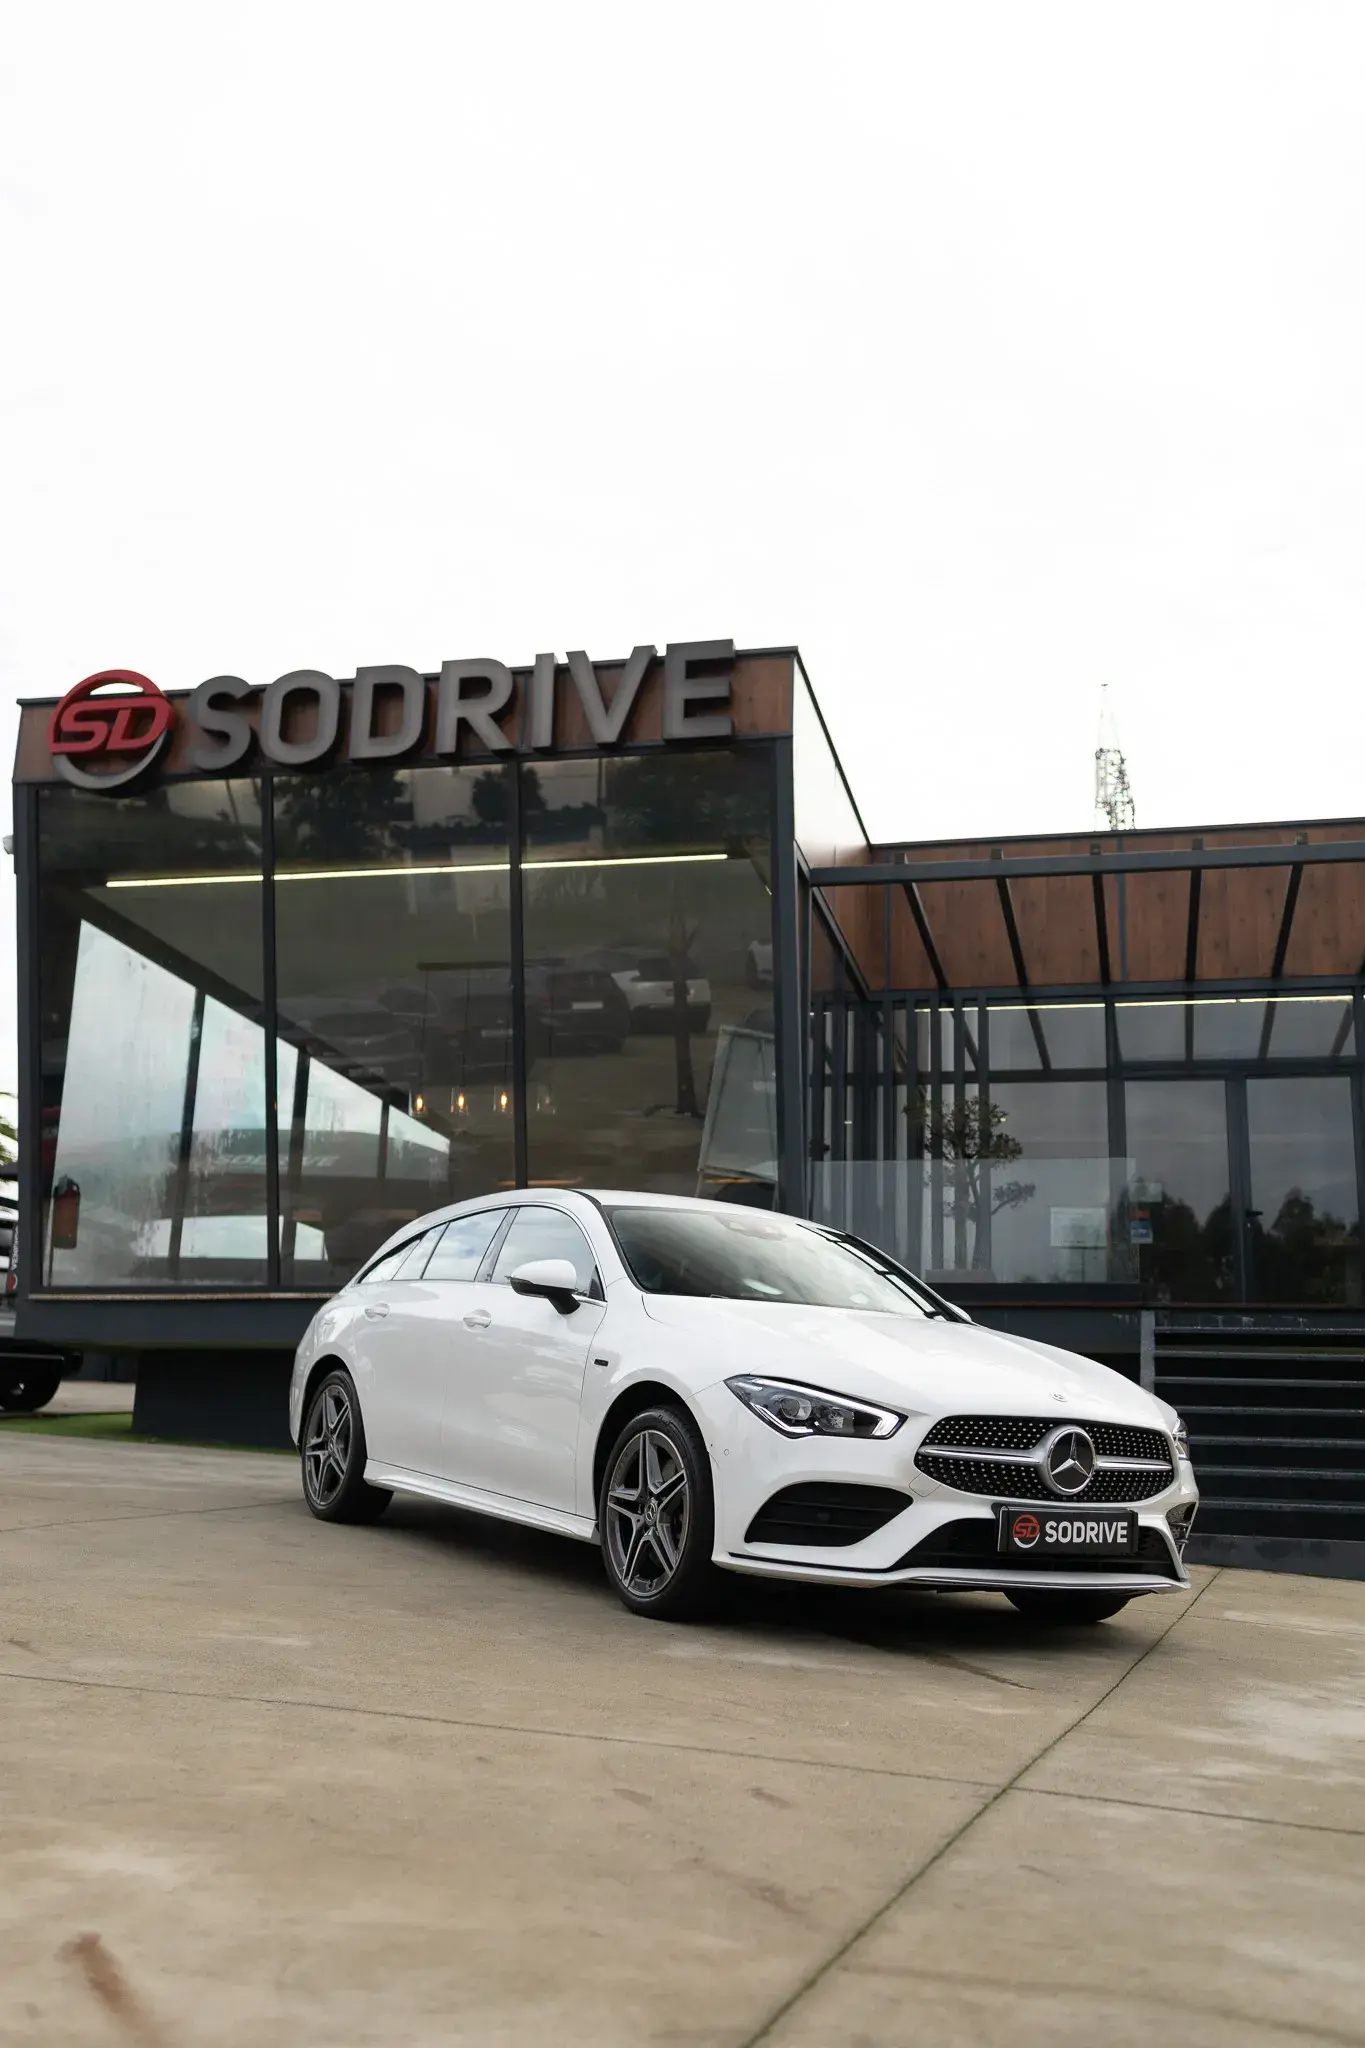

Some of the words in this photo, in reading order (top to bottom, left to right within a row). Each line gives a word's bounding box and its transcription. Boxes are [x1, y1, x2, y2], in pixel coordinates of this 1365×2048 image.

[51, 693, 176, 756] SD
[187, 639, 735, 771] SODRIVE
[1013, 1521, 1040, 1540] SD
[1045, 1520, 1128, 1544] SODRIVE
